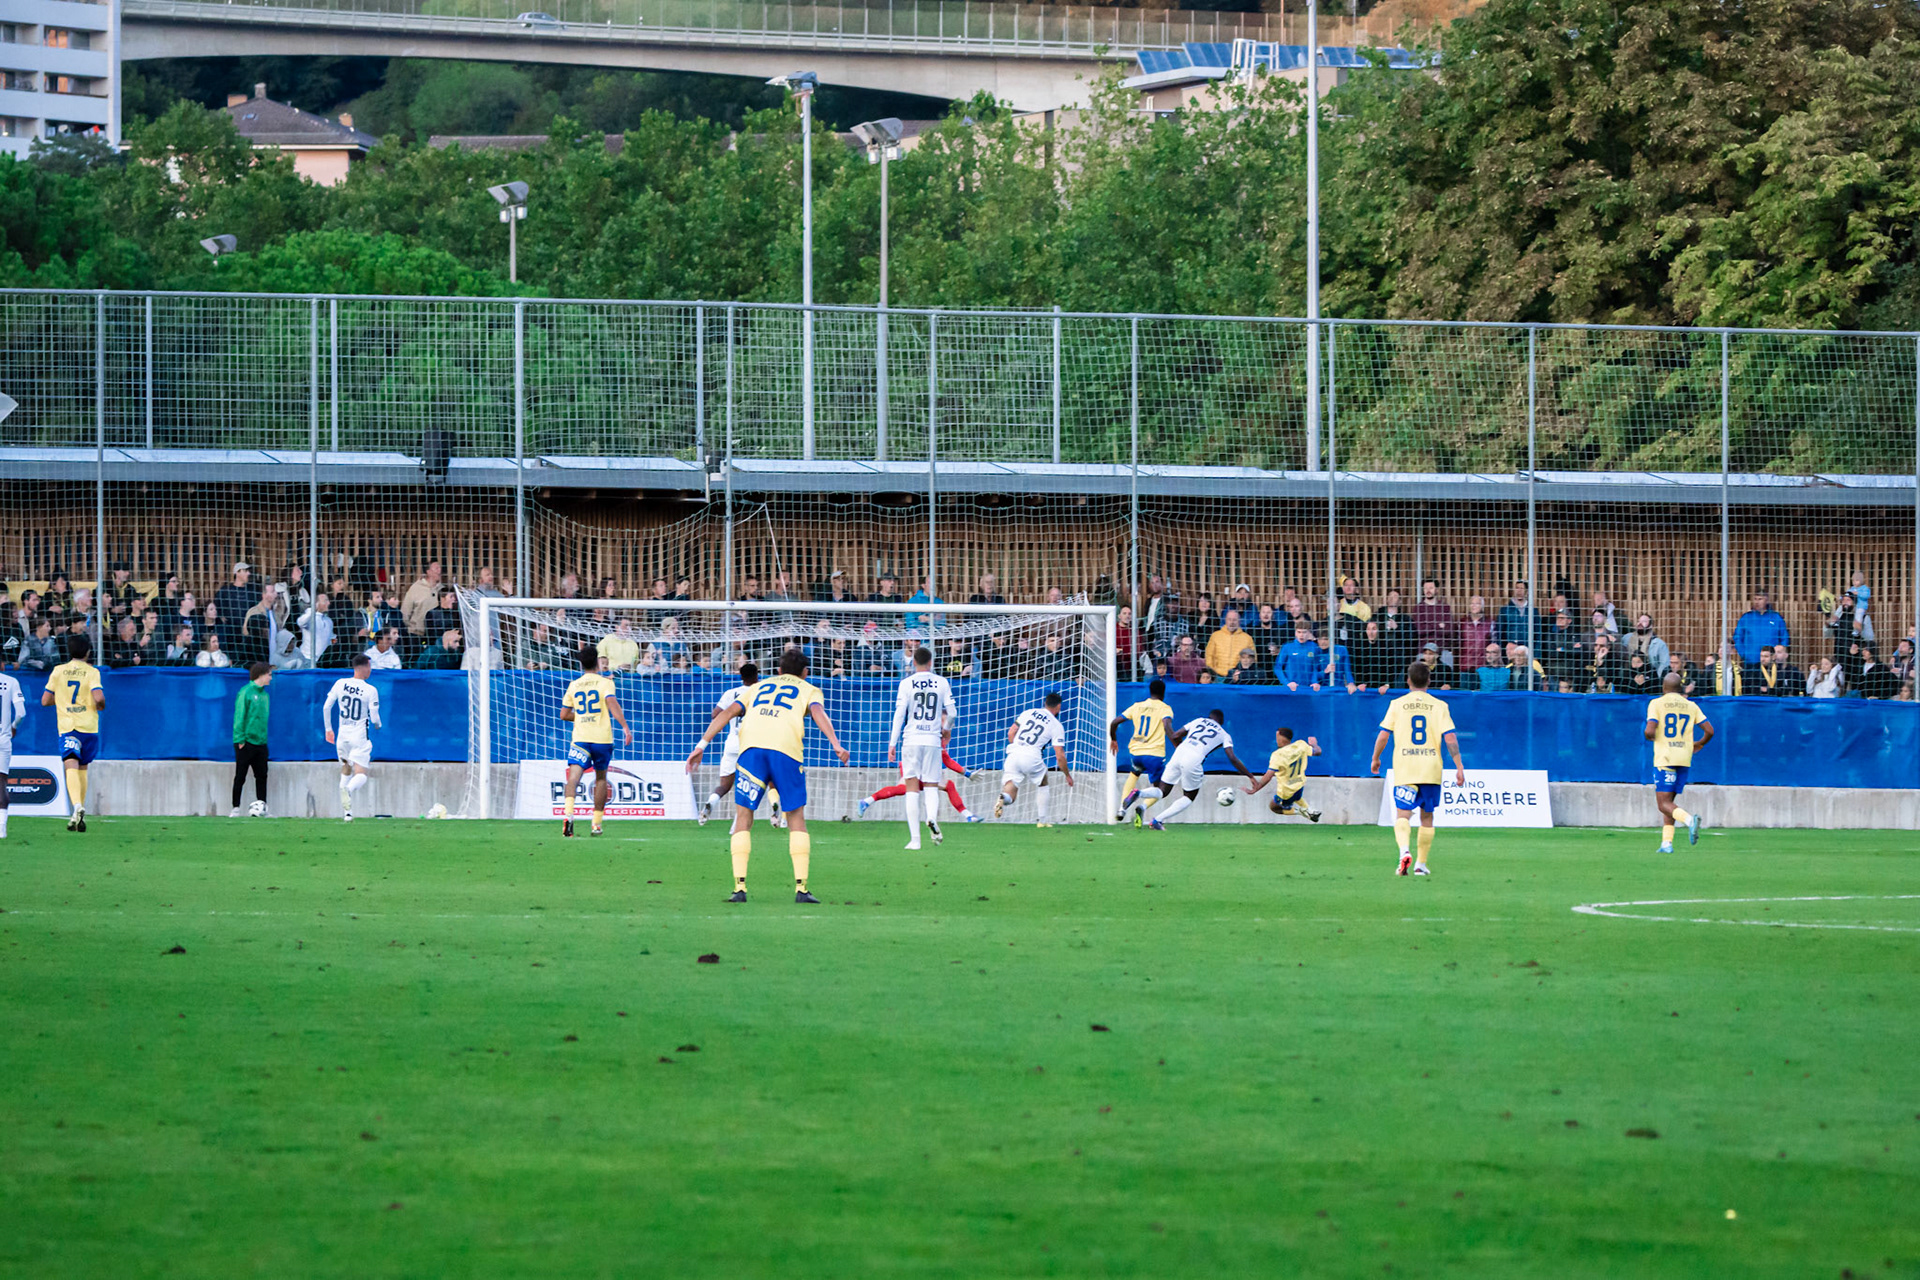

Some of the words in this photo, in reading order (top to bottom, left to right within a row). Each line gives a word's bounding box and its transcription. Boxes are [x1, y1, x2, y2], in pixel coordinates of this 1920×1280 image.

[67, 680, 81, 705] 7
[343, 683, 364, 697] kpt:
[912, 679, 938, 690] kpt:
[340, 695, 362, 721] 30
[574, 690, 602, 715] 32
[752, 683, 800, 711] 22
[913, 692, 938, 721] 39
[1403, 702, 1434, 712] OBRIST
[759, 707, 780, 718] DIAZ
[1031, 710, 1051, 725] kpt:
[1018, 719, 1045, 746] 23
[1138, 715, 1151, 737] 11
[1188, 724, 1218, 746] 22
[1411, 715, 1427, 745] 8
[1664, 713, 1691, 738] 87
[1443, 791, 1538, 806] BARRIÈRE
[1445, 808, 1504, 816] MONTREUX
